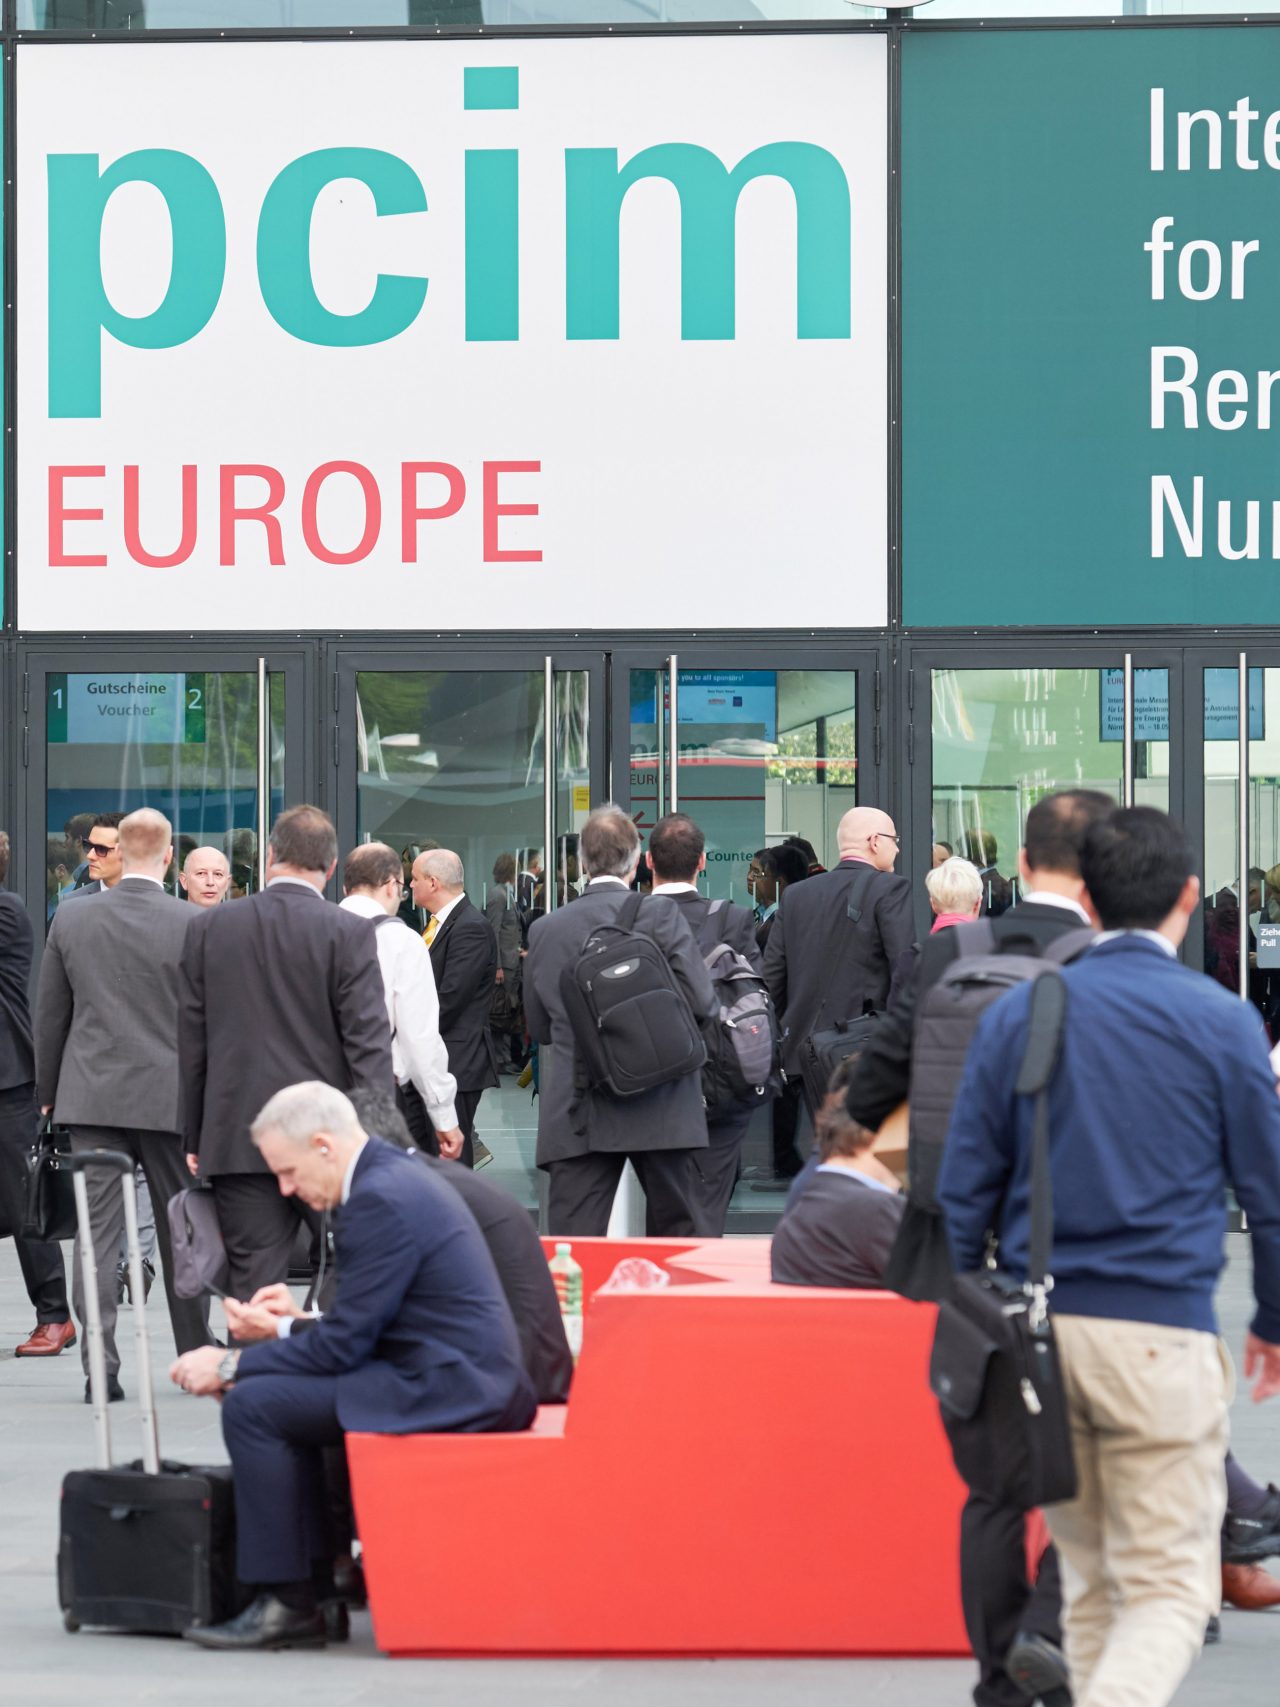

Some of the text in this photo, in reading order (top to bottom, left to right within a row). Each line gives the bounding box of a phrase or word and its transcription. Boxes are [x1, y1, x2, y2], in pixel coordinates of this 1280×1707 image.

[46, 66, 852, 419] pcim
[1143, 216, 1260, 301] for
[48, 460, 543, 569] EUROPE
[1151, 474, 1280, 561] Nu
[52, 688, 63, 709] 1
[87, 682, 167, 695] Gutscheine
[188, 688, 202, 710] 2
[97, 705, 157, 717] Voucher
[706, 851, 753, 862] Counte
[1261, 938, 1276, 947] Pull
